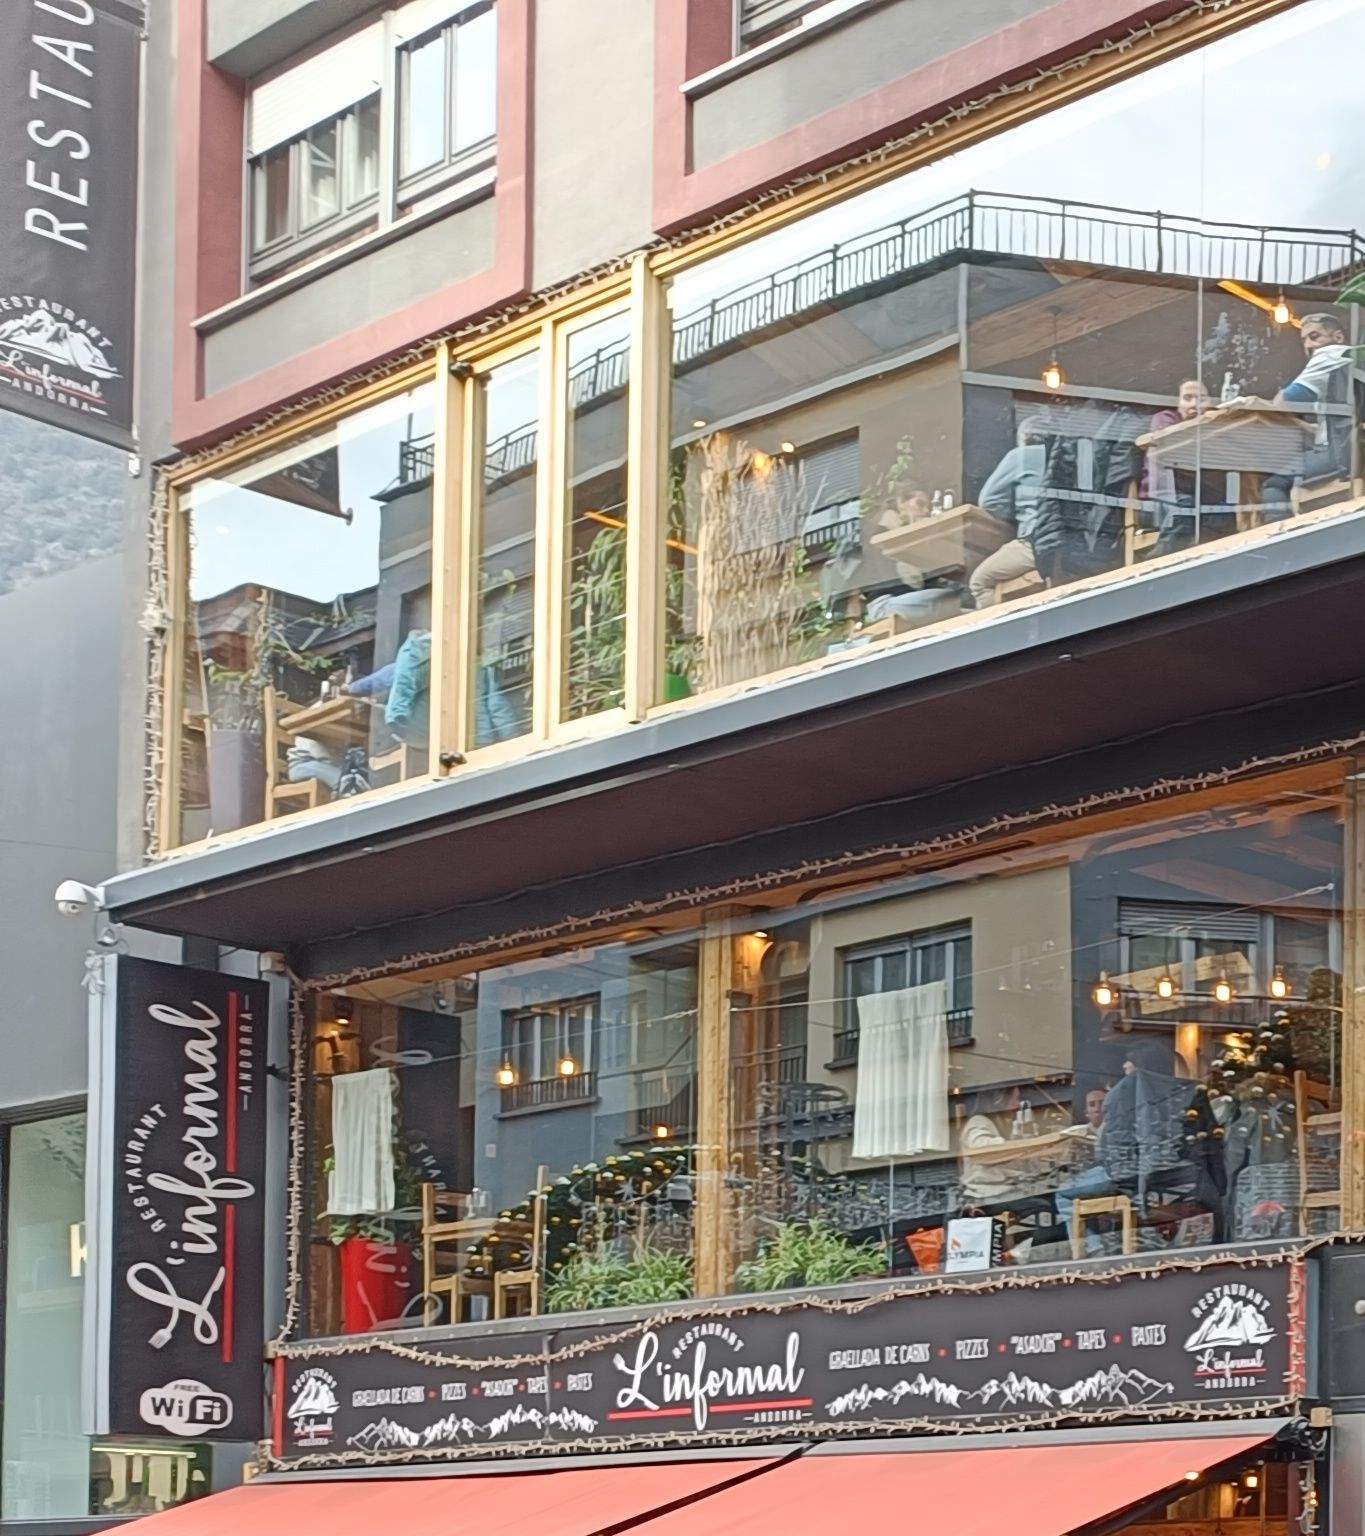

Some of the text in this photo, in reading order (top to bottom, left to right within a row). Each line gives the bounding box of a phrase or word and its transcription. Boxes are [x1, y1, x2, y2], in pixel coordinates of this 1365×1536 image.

[237, 1010, 255, 1095] ANDORRA
[125, 1103, 168, 1233] RESTAURANT
[126, 999, 256, 1350] L'informal
[671, 1322, 746, 1360] RESTAURANT
[1076, 1329, 1107, 1351] TAPES
[1191, 1283, 1271, 1318] RESTAURANT
[613, 1331, 805, 1431] L'informal
